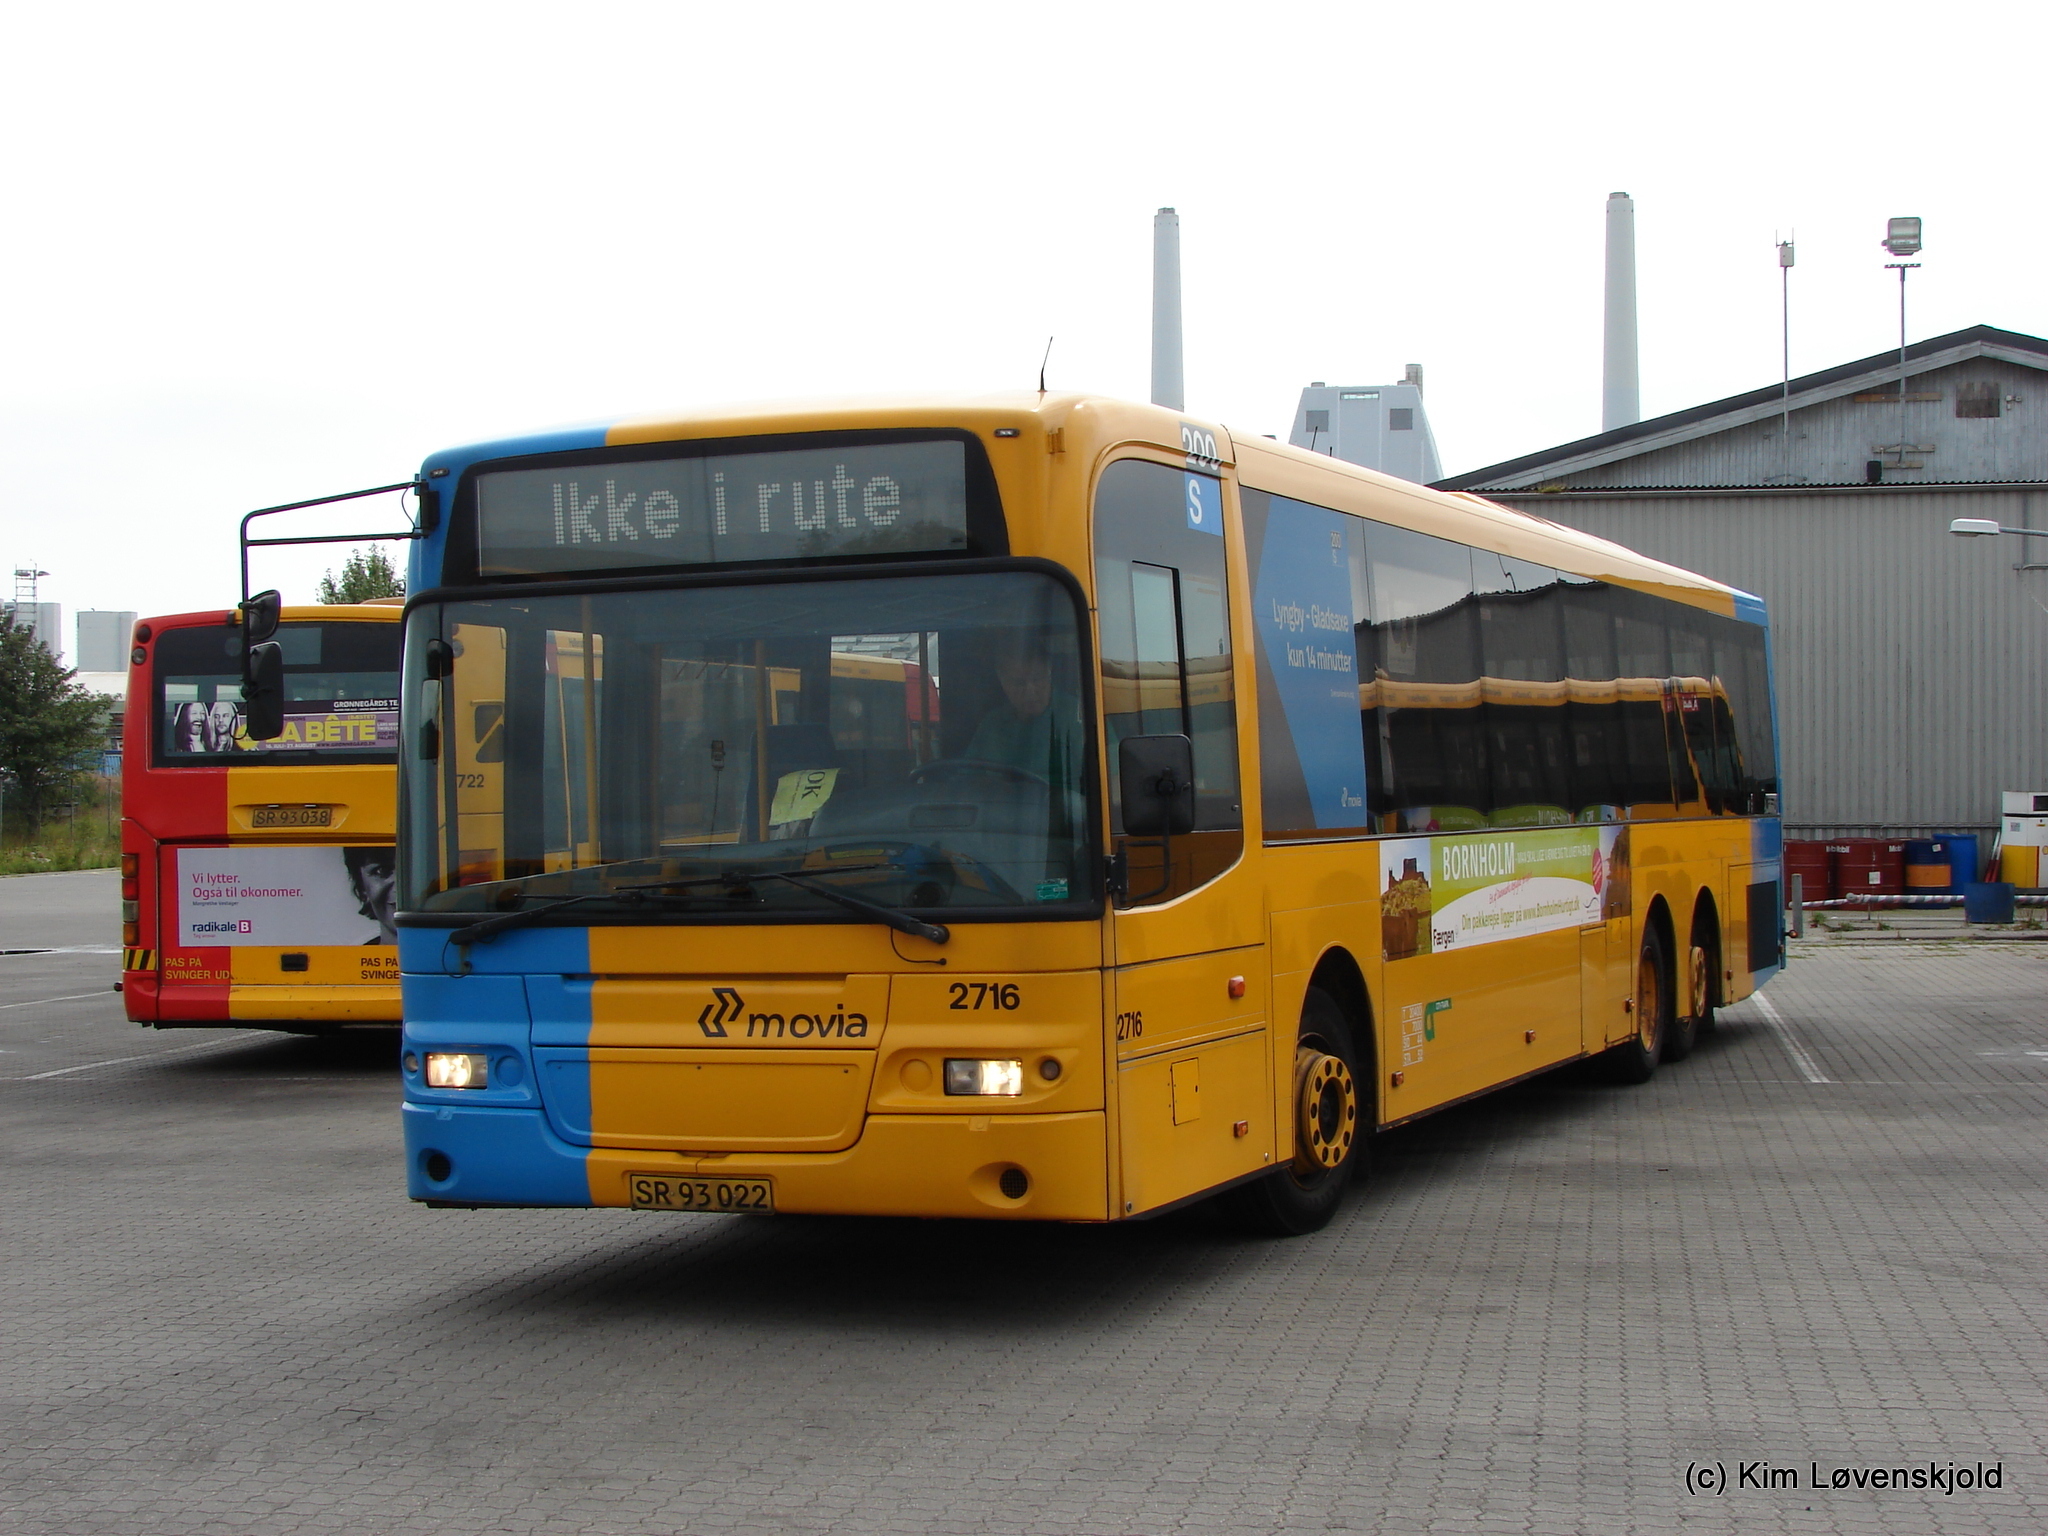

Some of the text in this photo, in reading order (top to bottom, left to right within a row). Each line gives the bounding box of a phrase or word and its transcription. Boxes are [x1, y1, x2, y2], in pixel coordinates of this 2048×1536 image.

[1182, 427, 1218, 471] 200
[553, 464, 900, 545] Ikke i rute
[1189, 479, 1202, 525] S
[1272, 597, 1304, 632] Lyngby
[1311, 604, 1349, 633] Gladsaxe
[1287, 642, 1351, 673] kun 14 minutter
[333, 699, 388, 708] GRØNNEGÅRDS
[305, 714, 376, 742] BÊTE
[457, 774, 485, 788] 722
[801, 771, 825, 800] OK
[256, 810, 329, 825] SR 93 038
[1442, 842, 1515, 881] BORNHOLM
[192, 873, 241, 886] Vi lytter.
[192, 886, 303, 900] Også til økonomer.
[192, 921, 250, 933] radikale B
[1462, 913, 1471, 930] Din
[1472, 910, 1499, 933] pakkerejse
[1500, 907, 1515, 928] ligger
[1515, 905, 1522, 926] på
[1433, 929, 1455, 949] Færgen
[165, 956, 202, 967] PAS PÅ
[165, 970, 230, 980] SVINGER UD
[361, 956, 398, 967] PAS PÅ
[361, 970, 400, 980] SVINGE
[949, 982, 1021, 1010] 2716
[747, 1003, 868, 1038] movia
[1117, 1011, 1142, 1041] 2716
[636, 1180, 768, 1208] SR 93 022
